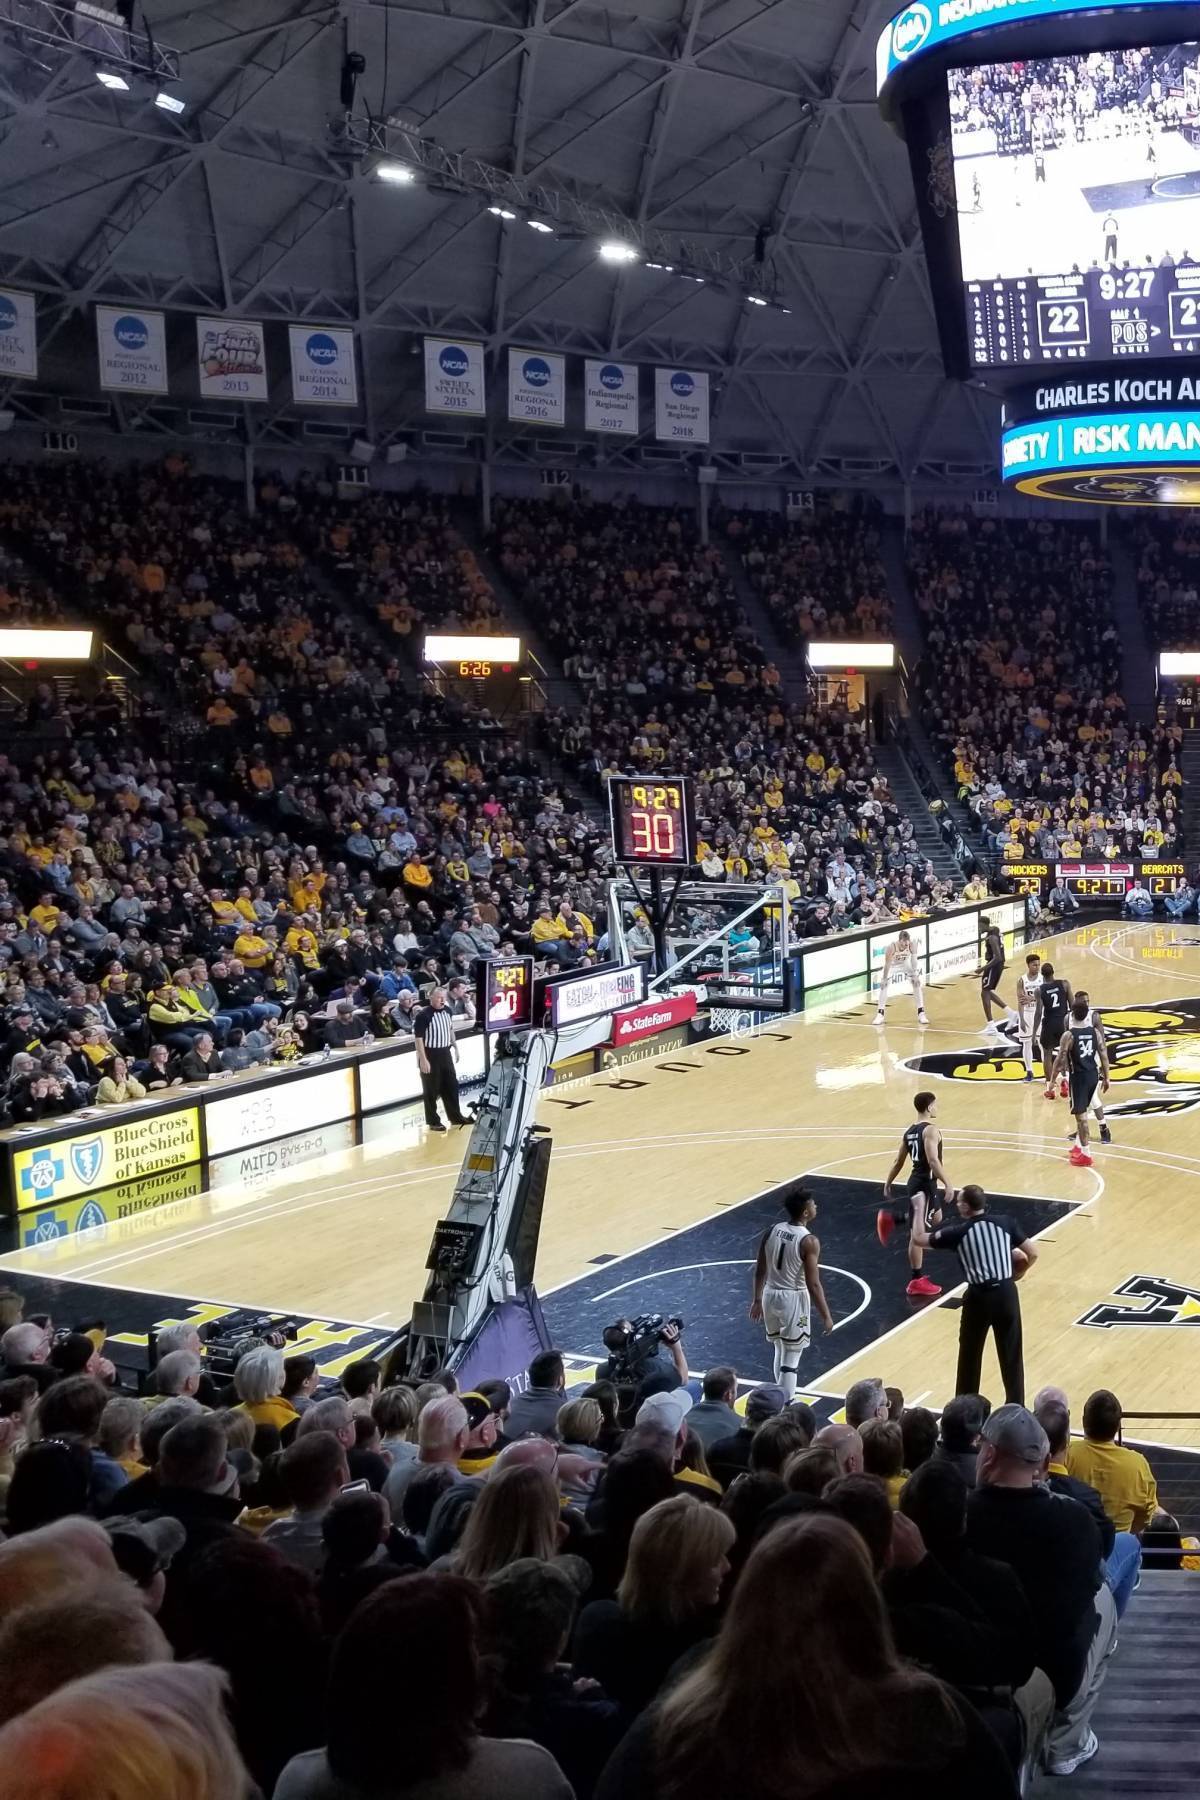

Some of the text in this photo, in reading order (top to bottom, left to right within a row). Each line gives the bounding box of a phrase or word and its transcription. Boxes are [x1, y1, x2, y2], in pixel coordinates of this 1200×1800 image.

[1099, 271, 1155, 300] 9:27
[1047, 305, 1080, 333] 22
[1133, 307, 1140, 319] 1
[118, 331, 148, 343] NCAA
[1112, 323, 1148, 343] POS
[216, 333, 257, 349] FINAL
[202, 342, 262, 365] FOUR
[309, 347, 338, 359] NCAA
[106, 360, 161, 372] REGIONAL
[441, 359, 468, 370] NCAA
[120, 372, 148, 384] 2012
[299, 375, 350, 385] REGIONAL
[525, 370, 550, 381] NCAA
[601, 375, 623, 385] NCAA
[223, 381, 249, 392] 2013
[311, 386, 338, 397] 2014
[434, 386, 476, 396] SIXTEEN
[443, 395, 468, 407] 2015
[514, 394, 560, 407] REGIONAL
[588, 388, 635, 401] Indianapolis
[1035, 383, 1110, 411] CHARLES
[1114, 378, 1172, 403] KOCH
[525, 405, 548, 417] 2016
[595, 400, 629, 410] Regional
[600, 418, 624, 428] 2017
[667, 411, 698, 421] Regional
[671, 425, 694, 437] 2018
[43, 432, 78, 451] 110
[1073, 424, 1130, 454] RISK
[338, 465, 371, 484] 111
[541, 469, 571, 485] 112
[786, 490, 814, 508] 113
[459, 661, 491, 675] 6:26
[633, 786, 680, 809] 9:27
[631, 812, 675, 854] 30
[1141, 864, 1184, 875] BEARCATS
[1077, 879, 1111, 894] 9:27
[1154, 878, 1176, 894] 21
[496, 967, 524, 987] 9:27
[1050, 993, 1060, 1008] 2
[1078, 1039, 1094, 1058] 34
[113, 1116, 189, 1146] BlueCross
[114, 1131, 195, 1164] BlueShield
[115, 1152, 187, 1181] of Kansas
[777, 1243, 786, 1270] 1
[505, 1270, 514, 1282] G
[505, 1369, 530, 1397] STA
